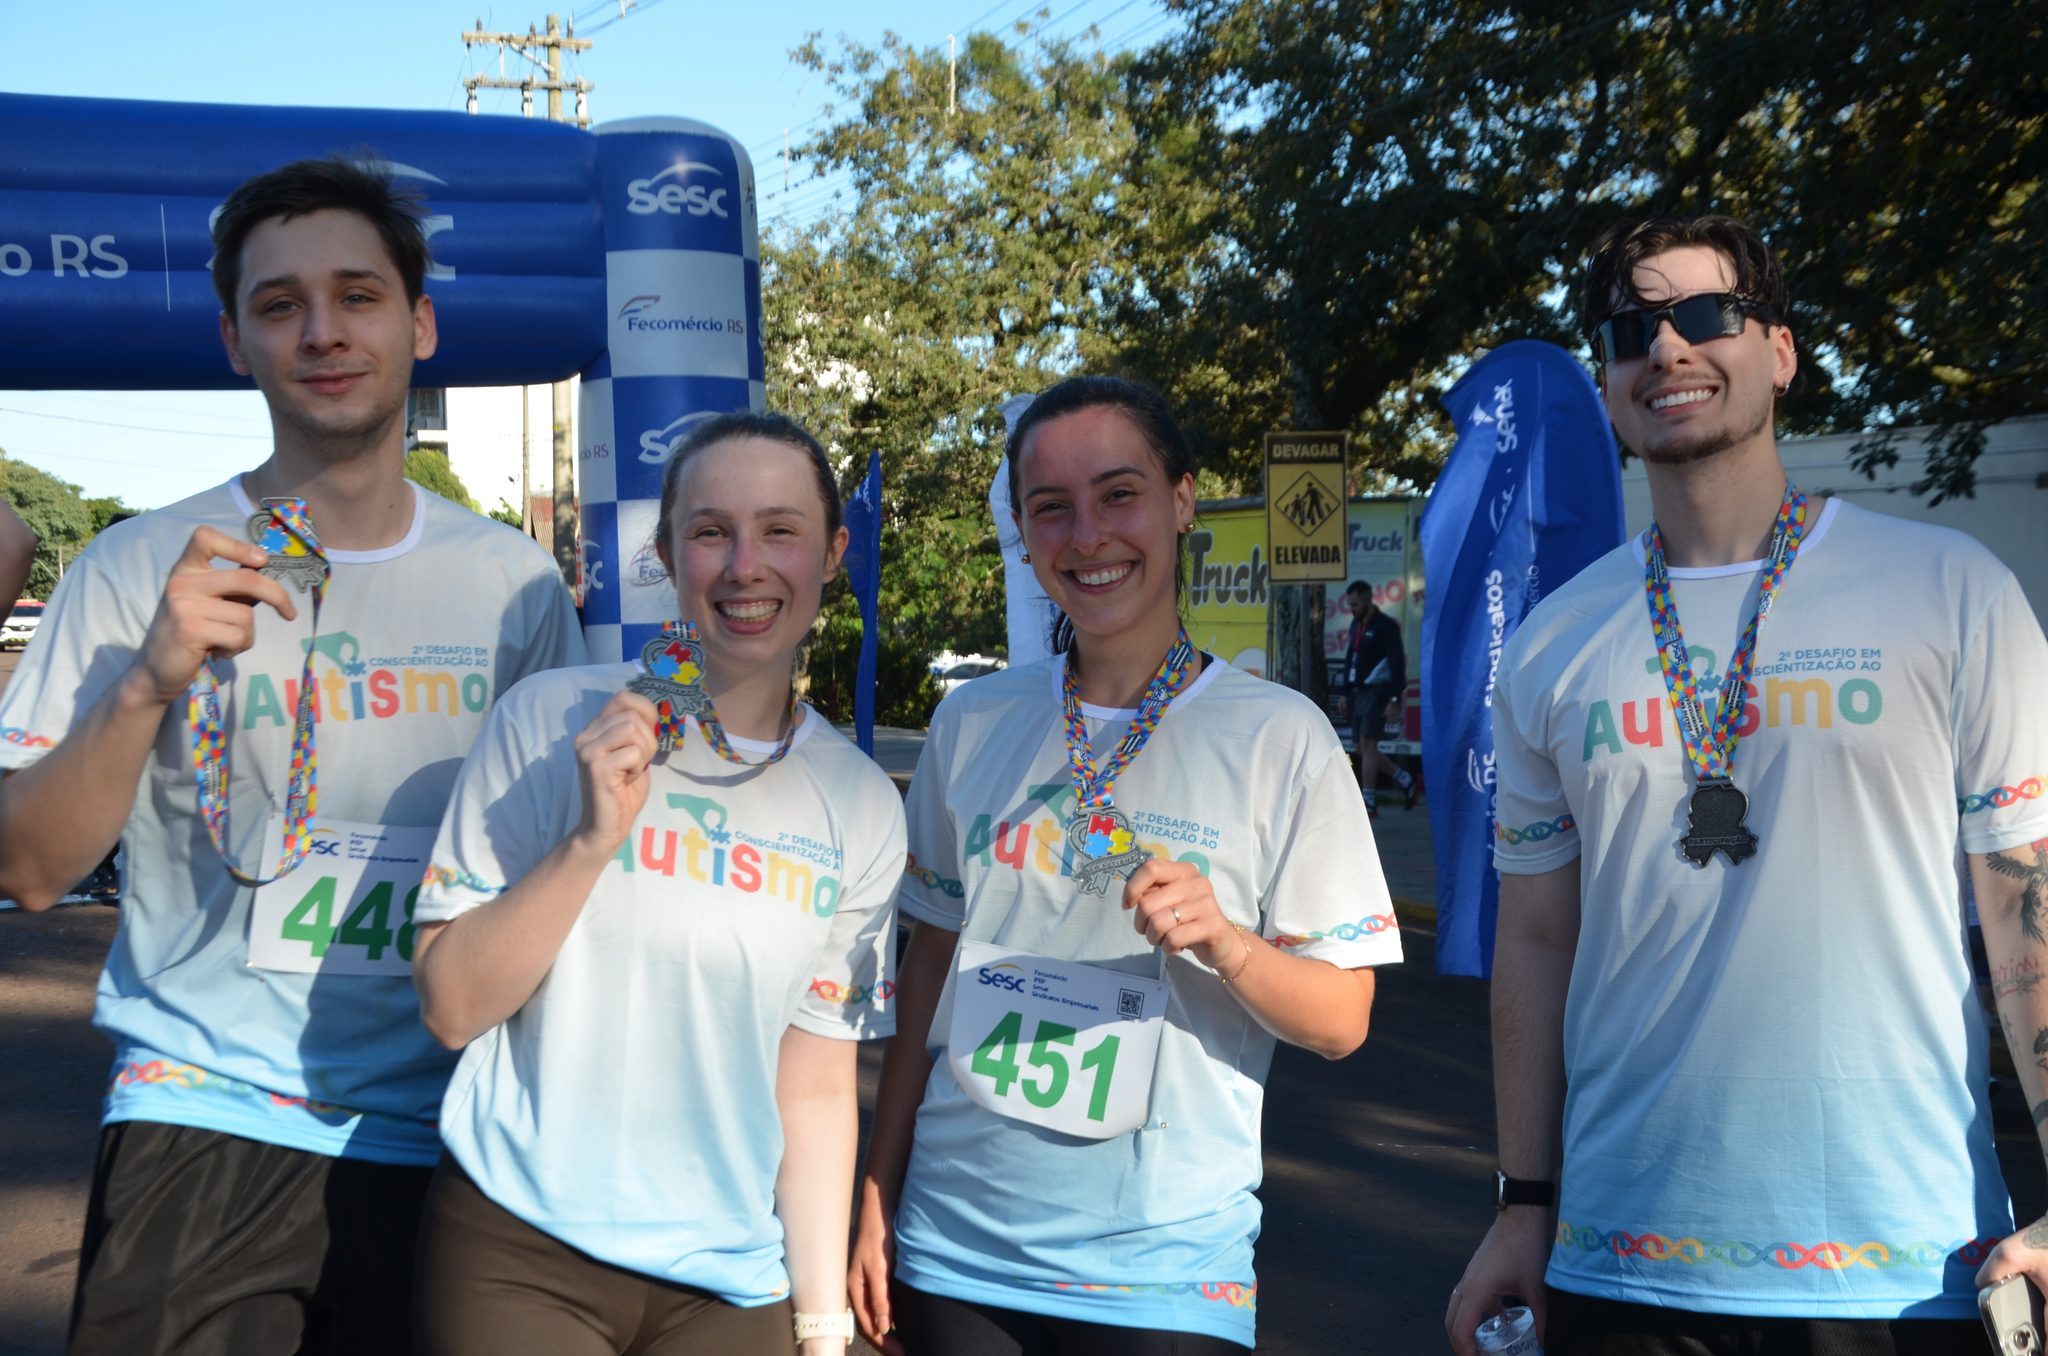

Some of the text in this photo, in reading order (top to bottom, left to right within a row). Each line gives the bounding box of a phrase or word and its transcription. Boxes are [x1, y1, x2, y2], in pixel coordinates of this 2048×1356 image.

[51, 234, 129, 279] RS
[628, 316, 744, 334] Fecomércio RS
[1273, 443, 1340, 458] DEVAGAR
[1347, 523, 1403, 552] Truck
[1188, 529, 1269, 607] Truck
[1275, 545, 1341, 565] ELEVADA
[369, 655, 489, 667] CONSCIENTIZAÇÃO AO
[426, 645, 473, 656] DESAFIO
[474, 647, 489, 656] EM
[1795, 648, 1857, 660] DESAFIO
[1861, 648, 1881, 659] EM
[1754, 658, 1881, 676] SCIENTIZAÇÃO AO
[243, 668, 488, 730] Autismo
[1582, 677, 1882, 762] Auismo
[1130, 821, 1217, 849] ENTIZAÇÃO AO
[1147, 813, 1200, 832] DESAFIO
[1203, 826, 1220, 839] EM
[735, 830, 841, 871] CONSCIENTIZAÇÃO A
[792, 834, 834, 857] DESAFIO
[835, 848, 843, 859] E
[971, 1010, 1121, 1122] 451
